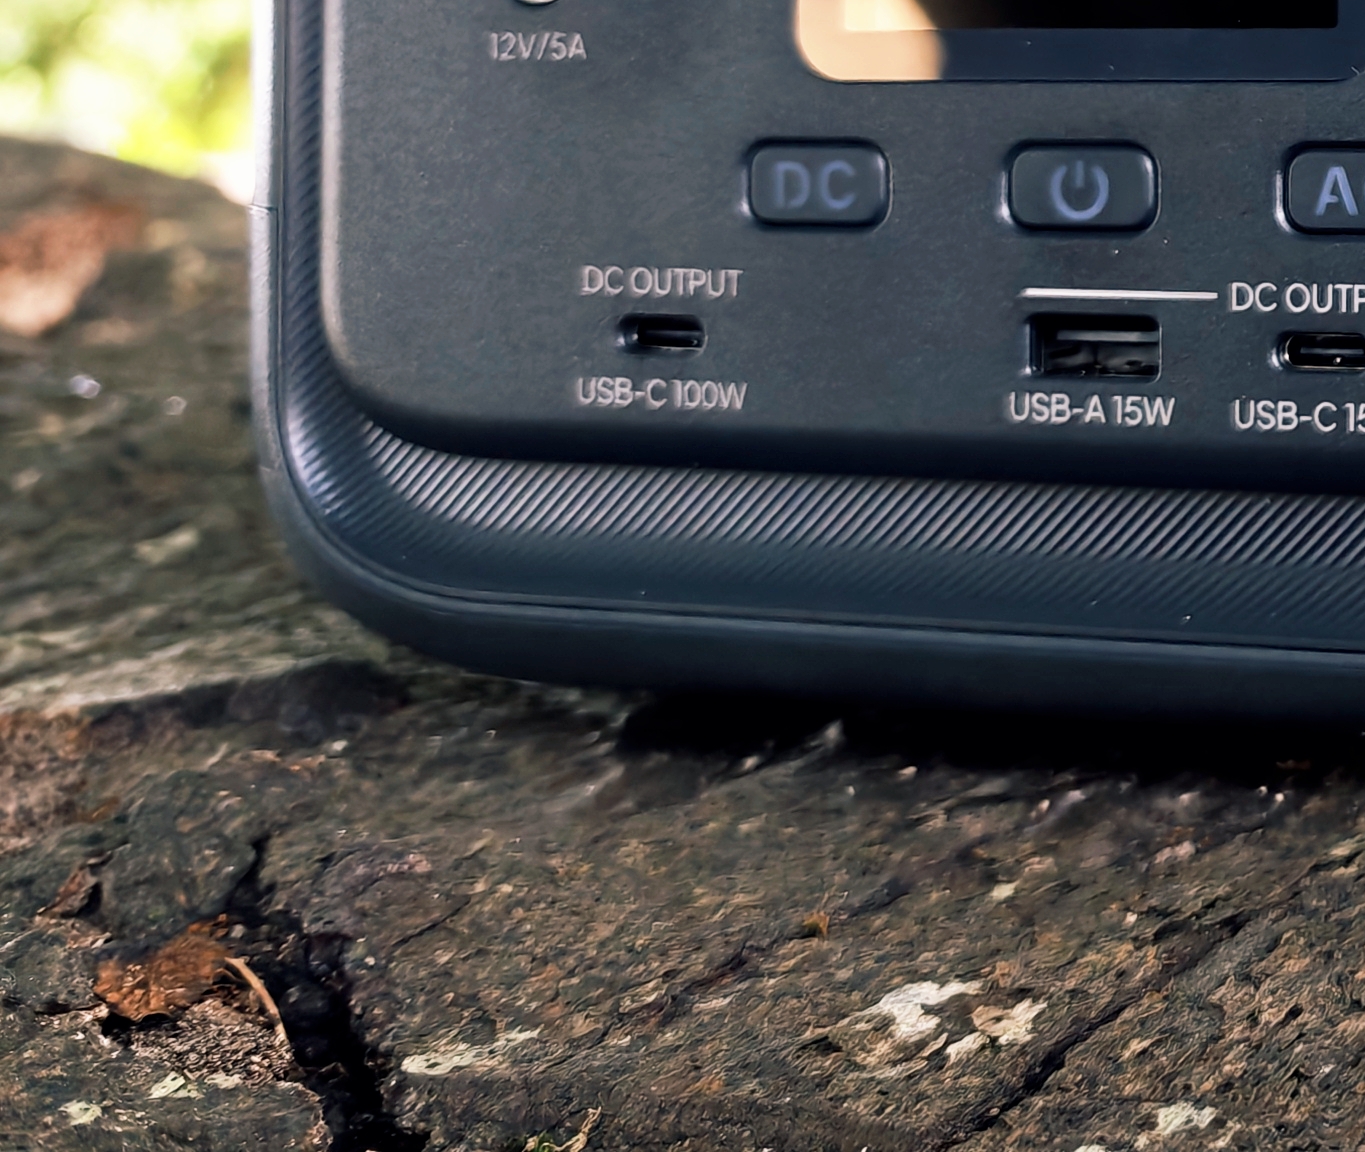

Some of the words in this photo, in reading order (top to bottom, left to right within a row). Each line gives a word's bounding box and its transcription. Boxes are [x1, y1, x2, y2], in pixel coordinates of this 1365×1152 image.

[489, 31, 588, 61] 12V/5A
[773, 160, 856, 211] DC
[581, 265, 625, 296] DC
[629, 266, 744, 298] OUTPUT
[1230, 281, 1278, 313] DC
[577, 376, 668, 410] USB-C
[671, 379, 749, 411] 100W
[1008, 390, 1106, 424] USB-A
[1111, 395, 1177, 427] 15W
[1233, 398, 1339, 434] USB-C
